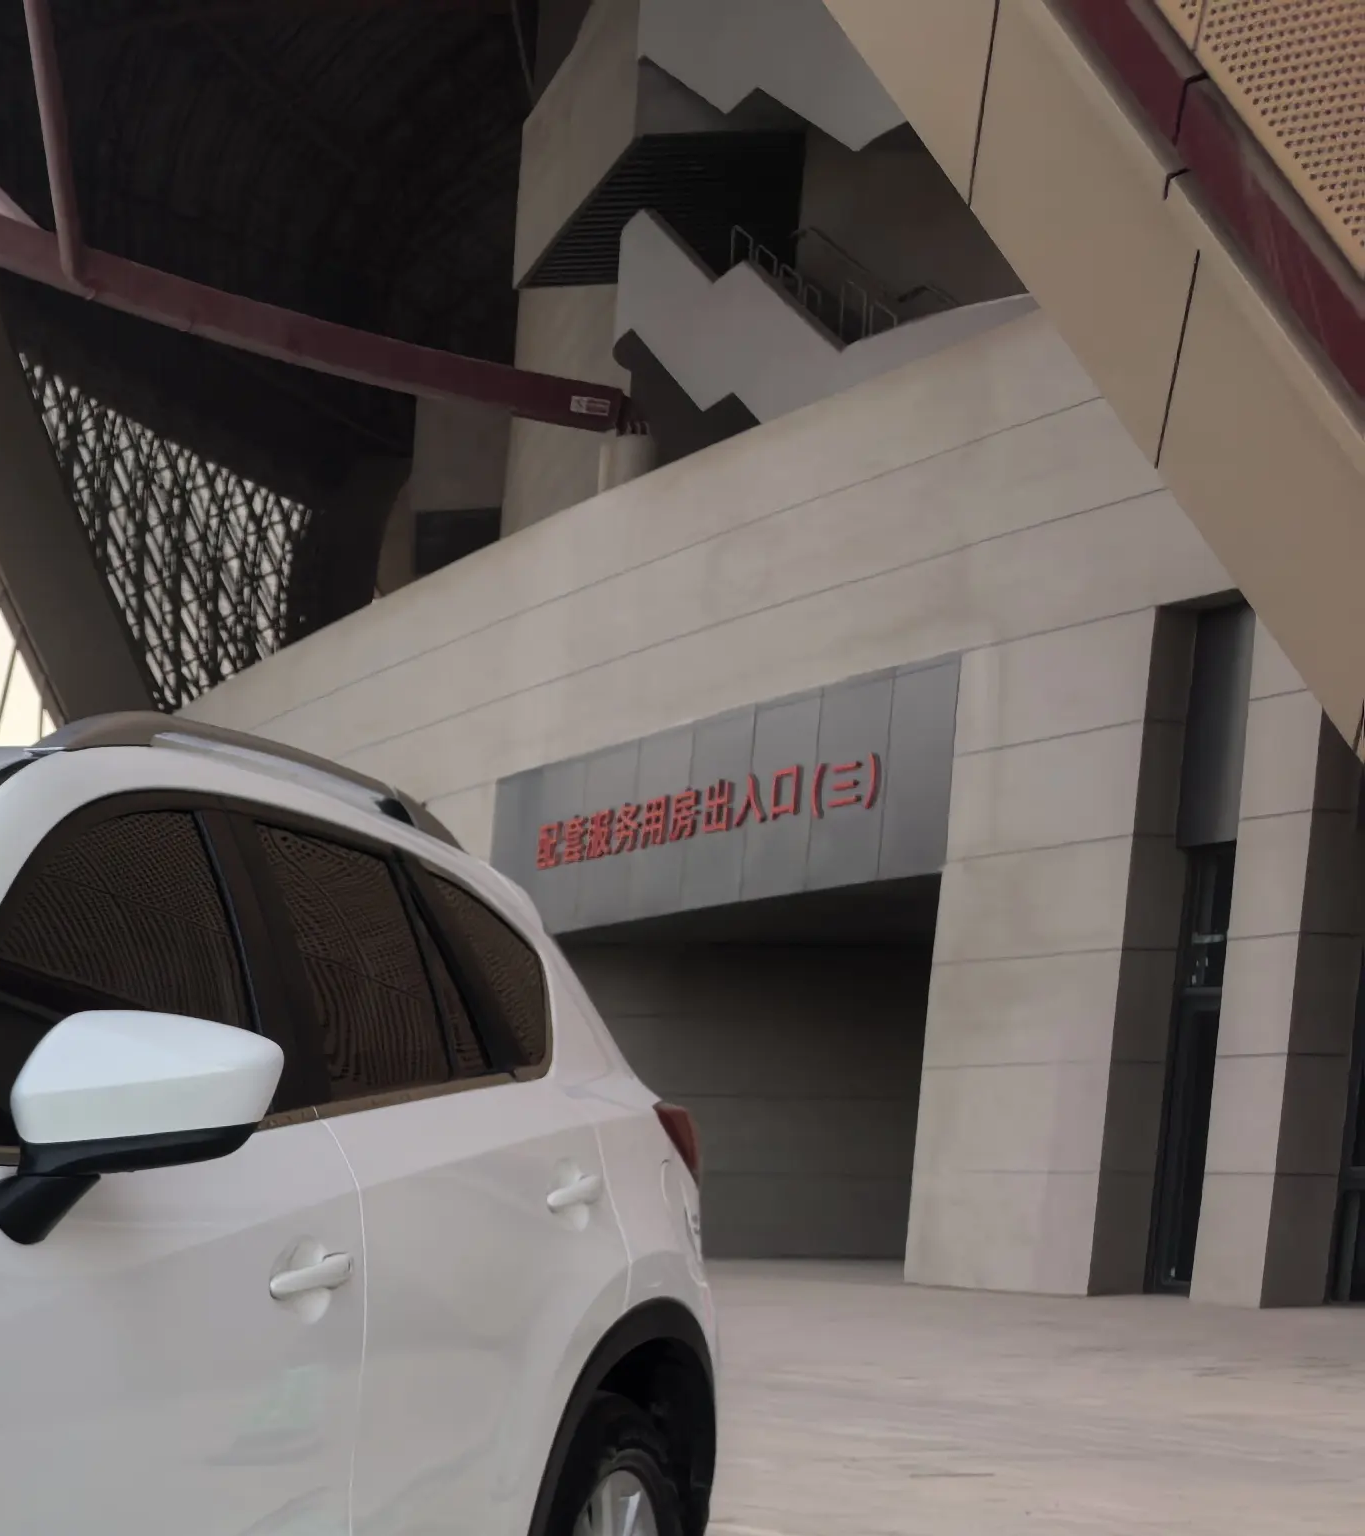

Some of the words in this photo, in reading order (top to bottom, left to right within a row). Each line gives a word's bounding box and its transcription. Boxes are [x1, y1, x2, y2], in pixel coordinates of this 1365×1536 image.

[536, 752, 882, 870] 配套服务用房出入口(三)
